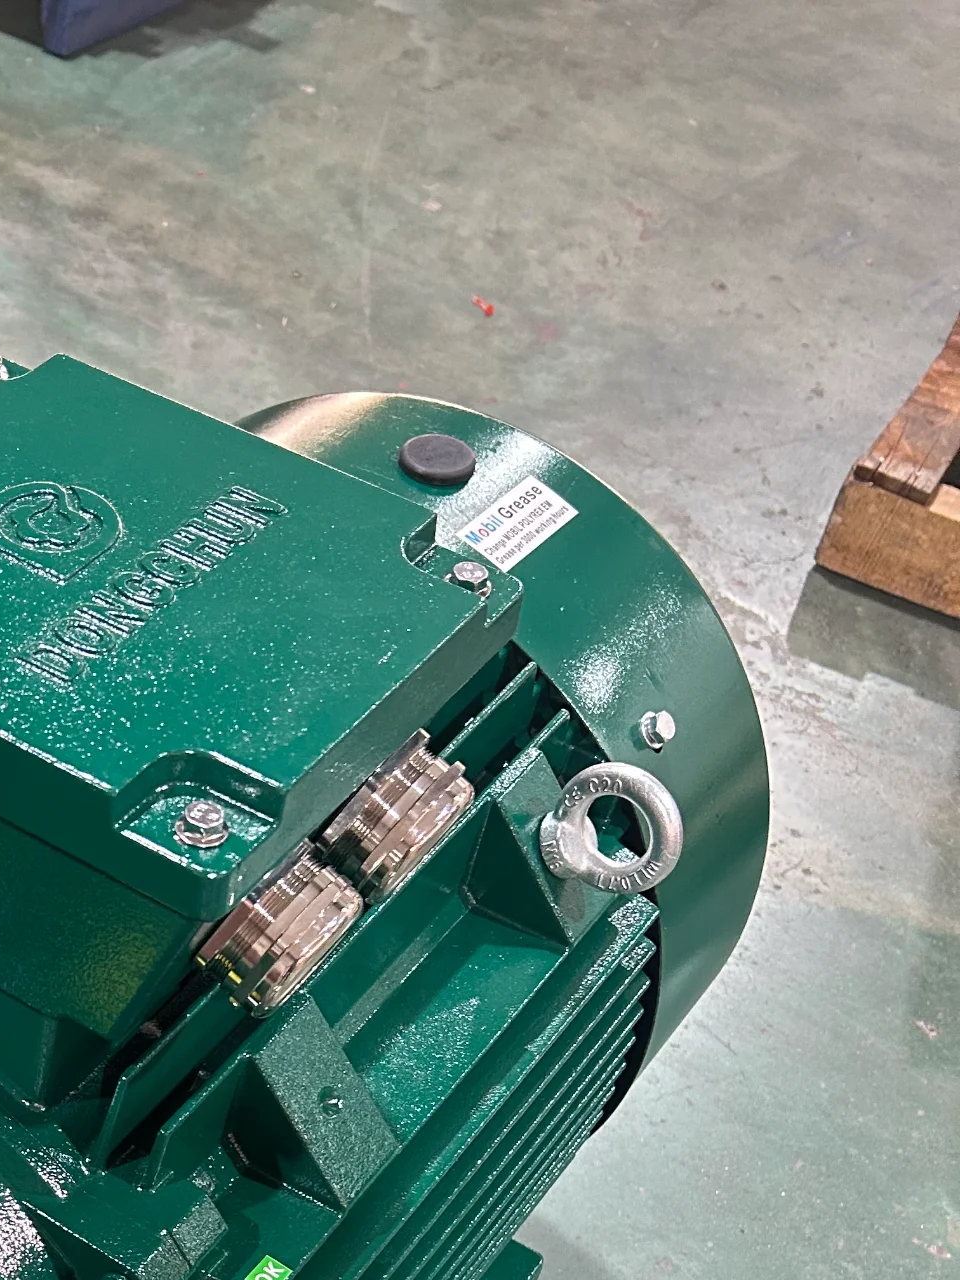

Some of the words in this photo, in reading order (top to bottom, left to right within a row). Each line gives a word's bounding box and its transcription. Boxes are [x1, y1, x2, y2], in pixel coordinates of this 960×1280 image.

[464, 514, 504, 545] Mobil
[497, 485, 543, 519] Grease
[484, 536, 508, 556] Change
[503, 523, 523, 543] MOBIL
[520, 506, 546, 529] POLYREX
[544, 500, 553, 511] EM
[495, 547, 518, 565] Grease
[514, 541, 525, 554] per
[523, 530, 537, 546] 3000
[535, 515, 557, 536] working
[553, 505, 570, 522] hours
[11, 484, 289, 687] DONGCHUN
